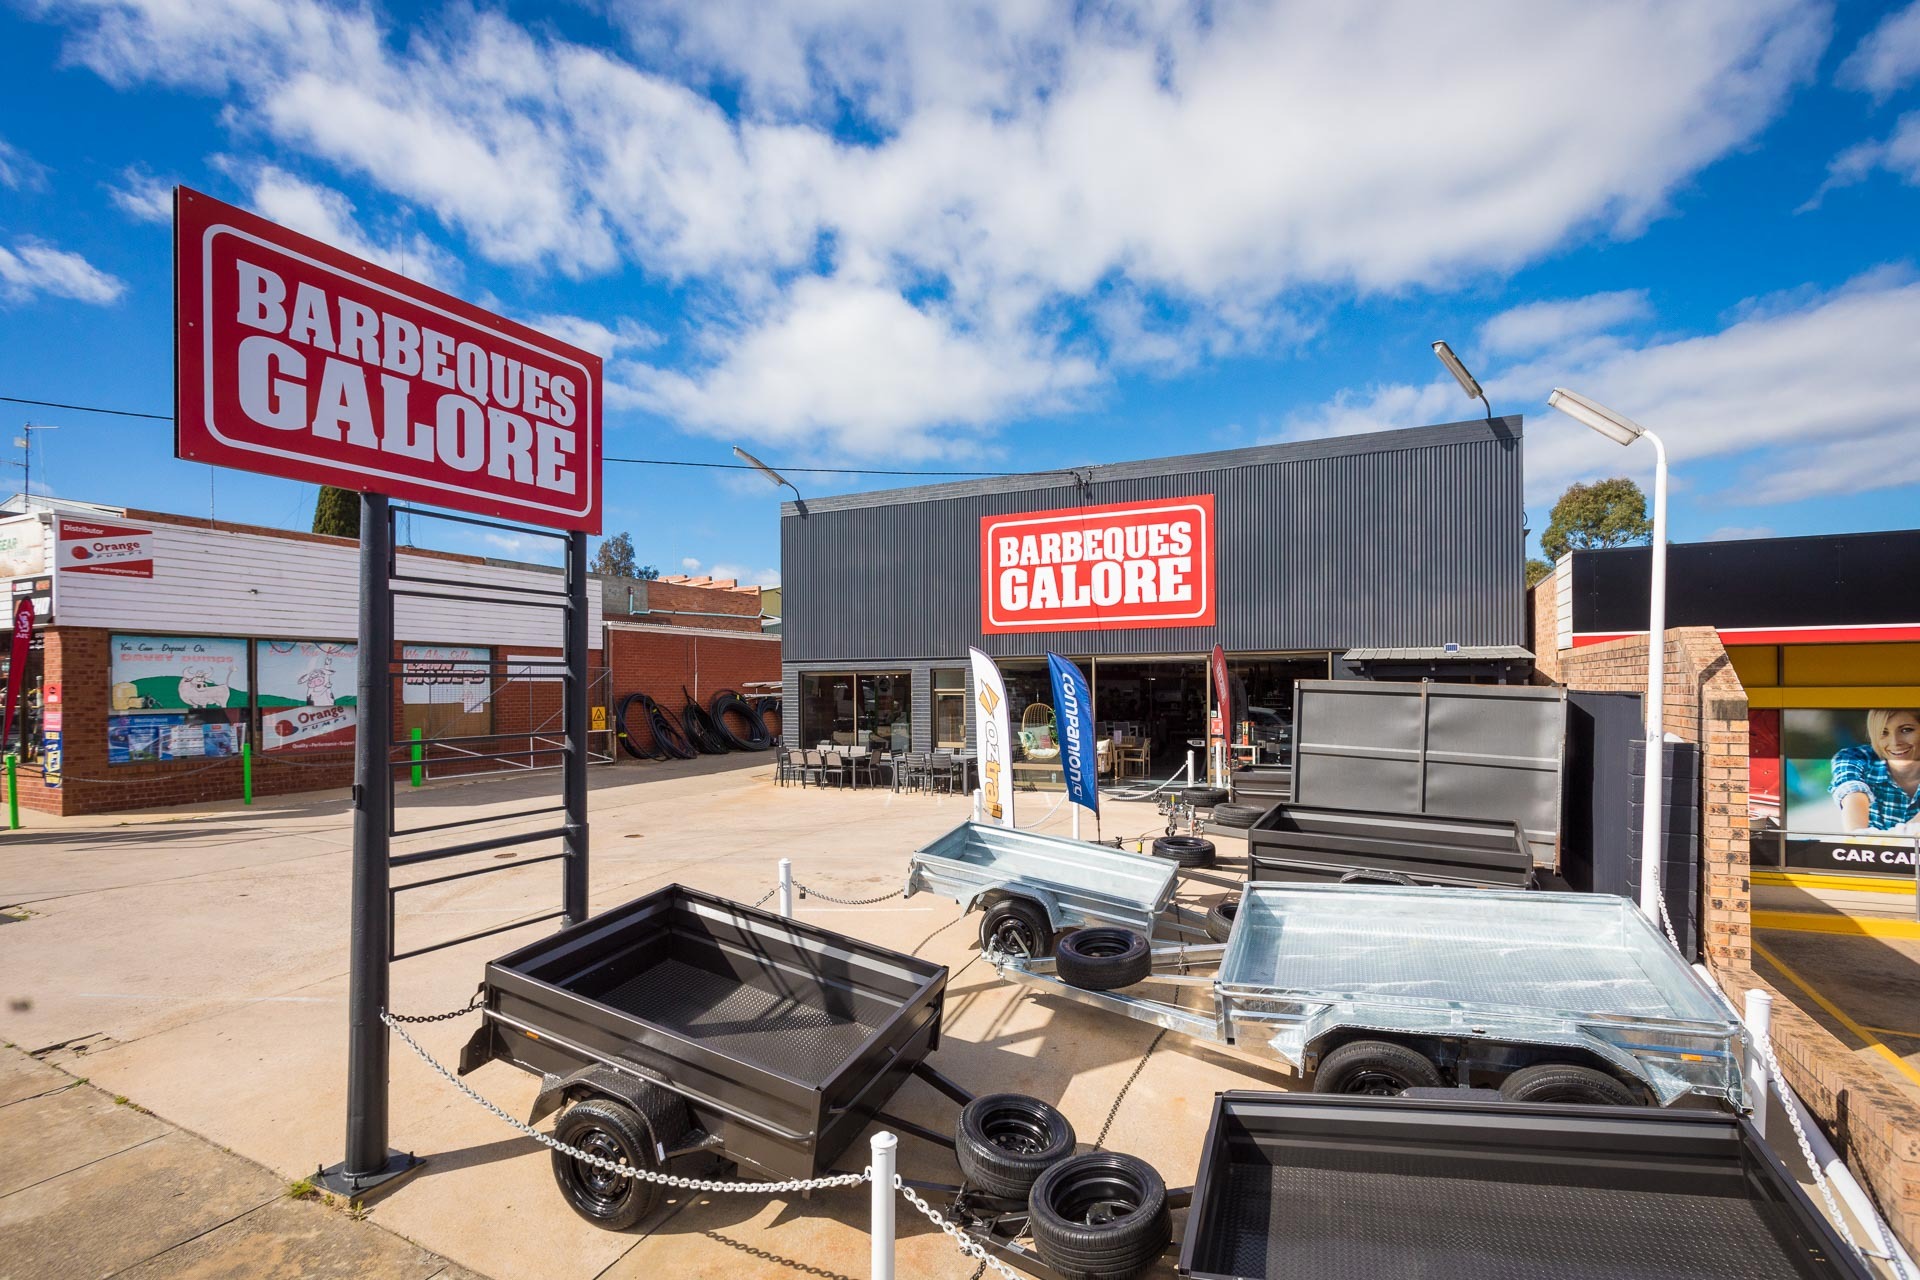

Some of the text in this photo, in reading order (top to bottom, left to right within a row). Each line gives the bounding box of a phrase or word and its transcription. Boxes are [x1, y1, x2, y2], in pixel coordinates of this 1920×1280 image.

[236, 258, 576, 427] BARBEQUES
[238, 335, 576, 495] GALORE
[63, 524, 105, 535] Distributor
[999, 521, 1192, 567] BARBEQUES
[93, 541, 141, 552] Orange
[1000, 556, 1192, 611] GALORE
[120, 642, 205, 654] You Can Depend On
[297, 706, 344, 724] Orange
[1062, 672, 1082, 783] companion
[1832, 848, 1875, 863] CAR
